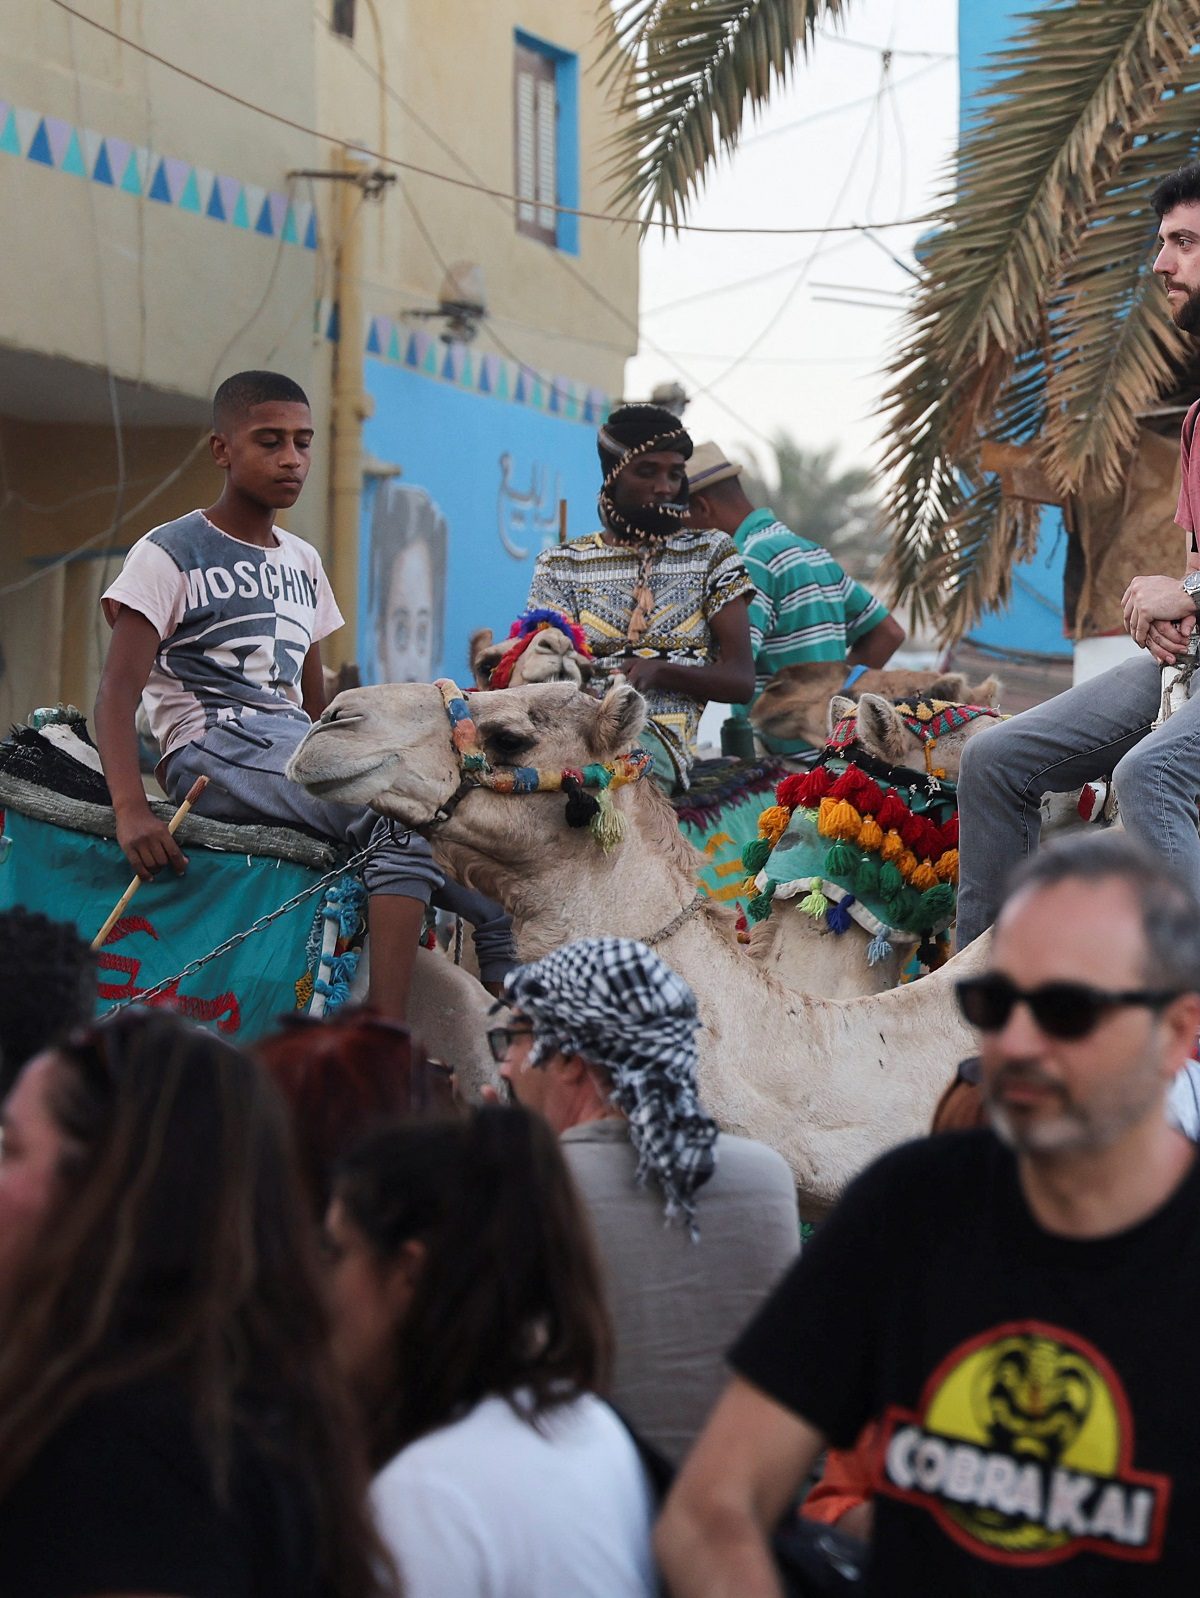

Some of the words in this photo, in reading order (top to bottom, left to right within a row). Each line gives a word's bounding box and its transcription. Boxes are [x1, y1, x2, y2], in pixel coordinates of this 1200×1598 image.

[181, 560, 319, 611] MOSCHIN
[886, 1427, 1043, 1520] COBRA
[1045, 1468, 1152, 1546] KAI
